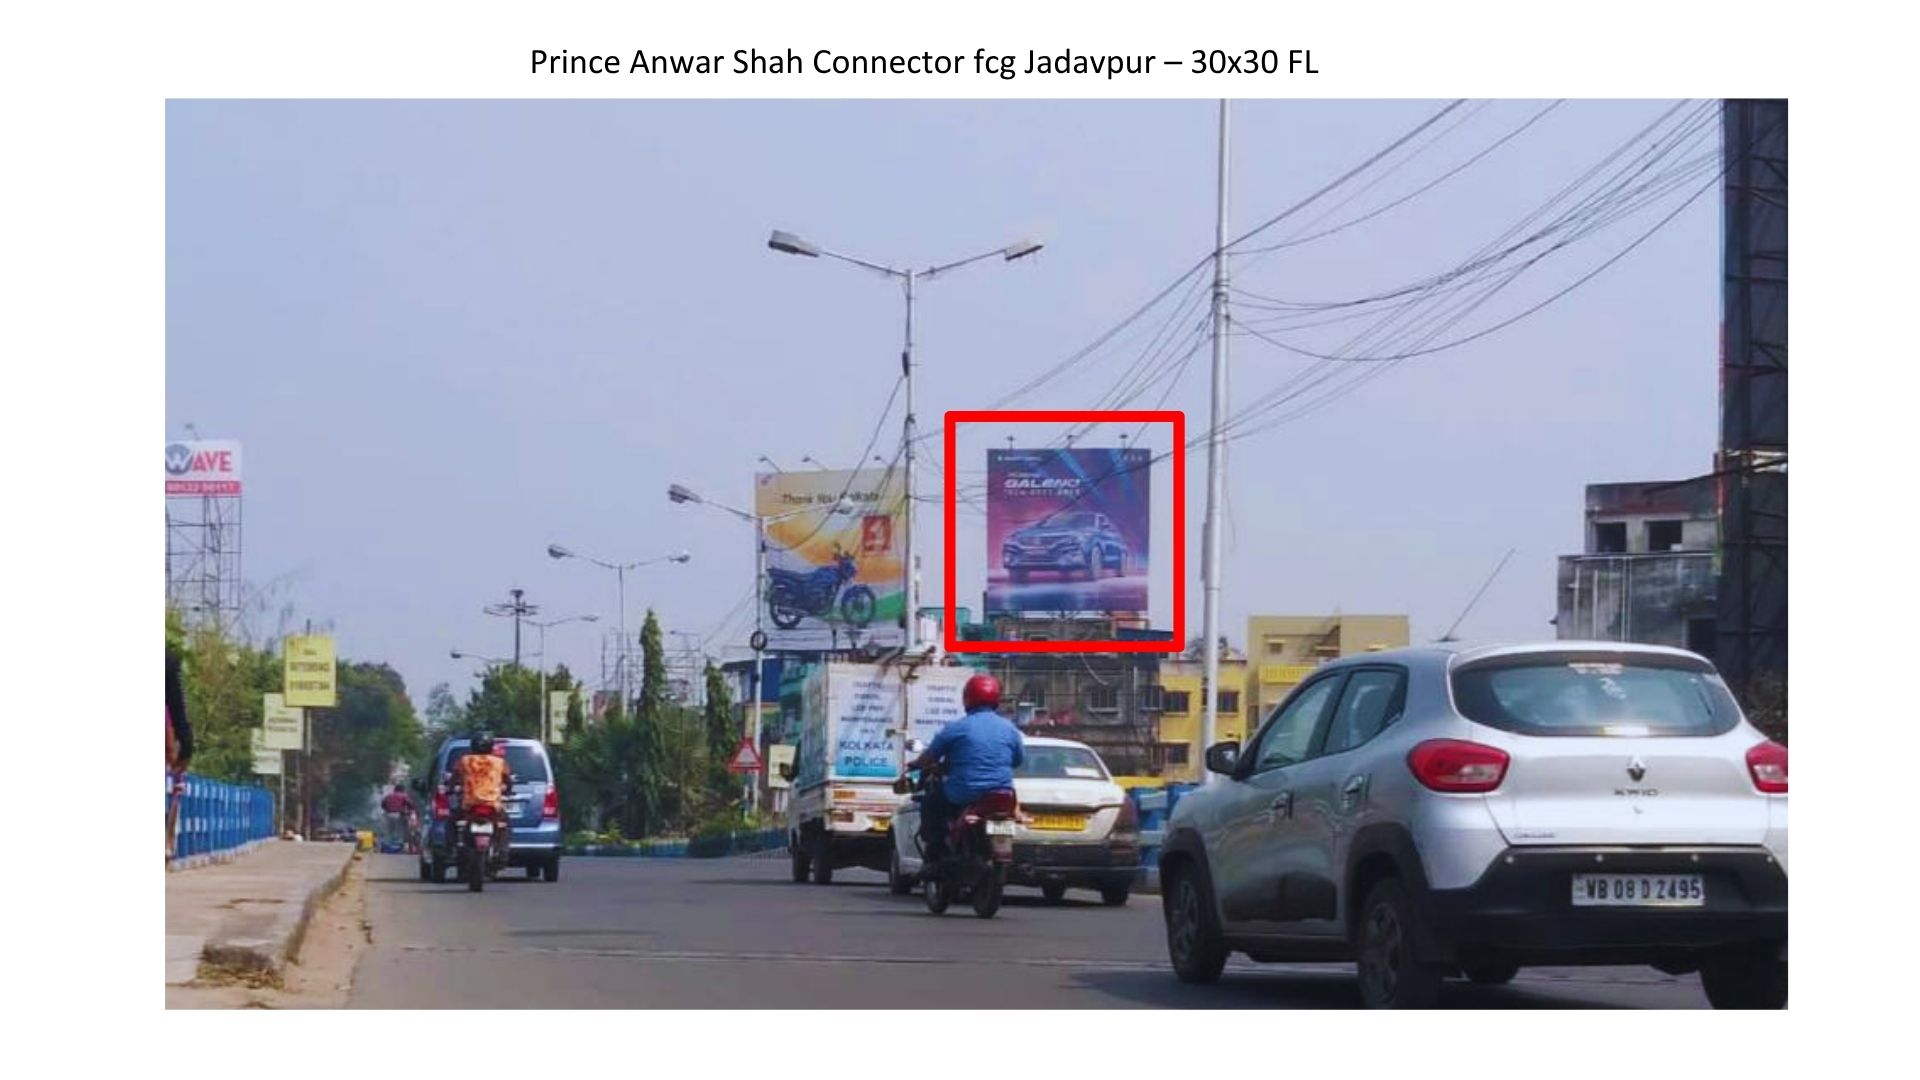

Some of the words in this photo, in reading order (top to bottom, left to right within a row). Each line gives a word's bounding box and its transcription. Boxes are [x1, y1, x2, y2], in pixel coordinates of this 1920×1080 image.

[839, 740, 894, 751] KOLKATA
[844, 755, 888, 767] POLICE
[1586, 879, 1608, 899] WB
[1614, 879, 1635, 899] 08
[1641, 879, 1651, 899] D
[1656, 879, 1700, 899] 2495
